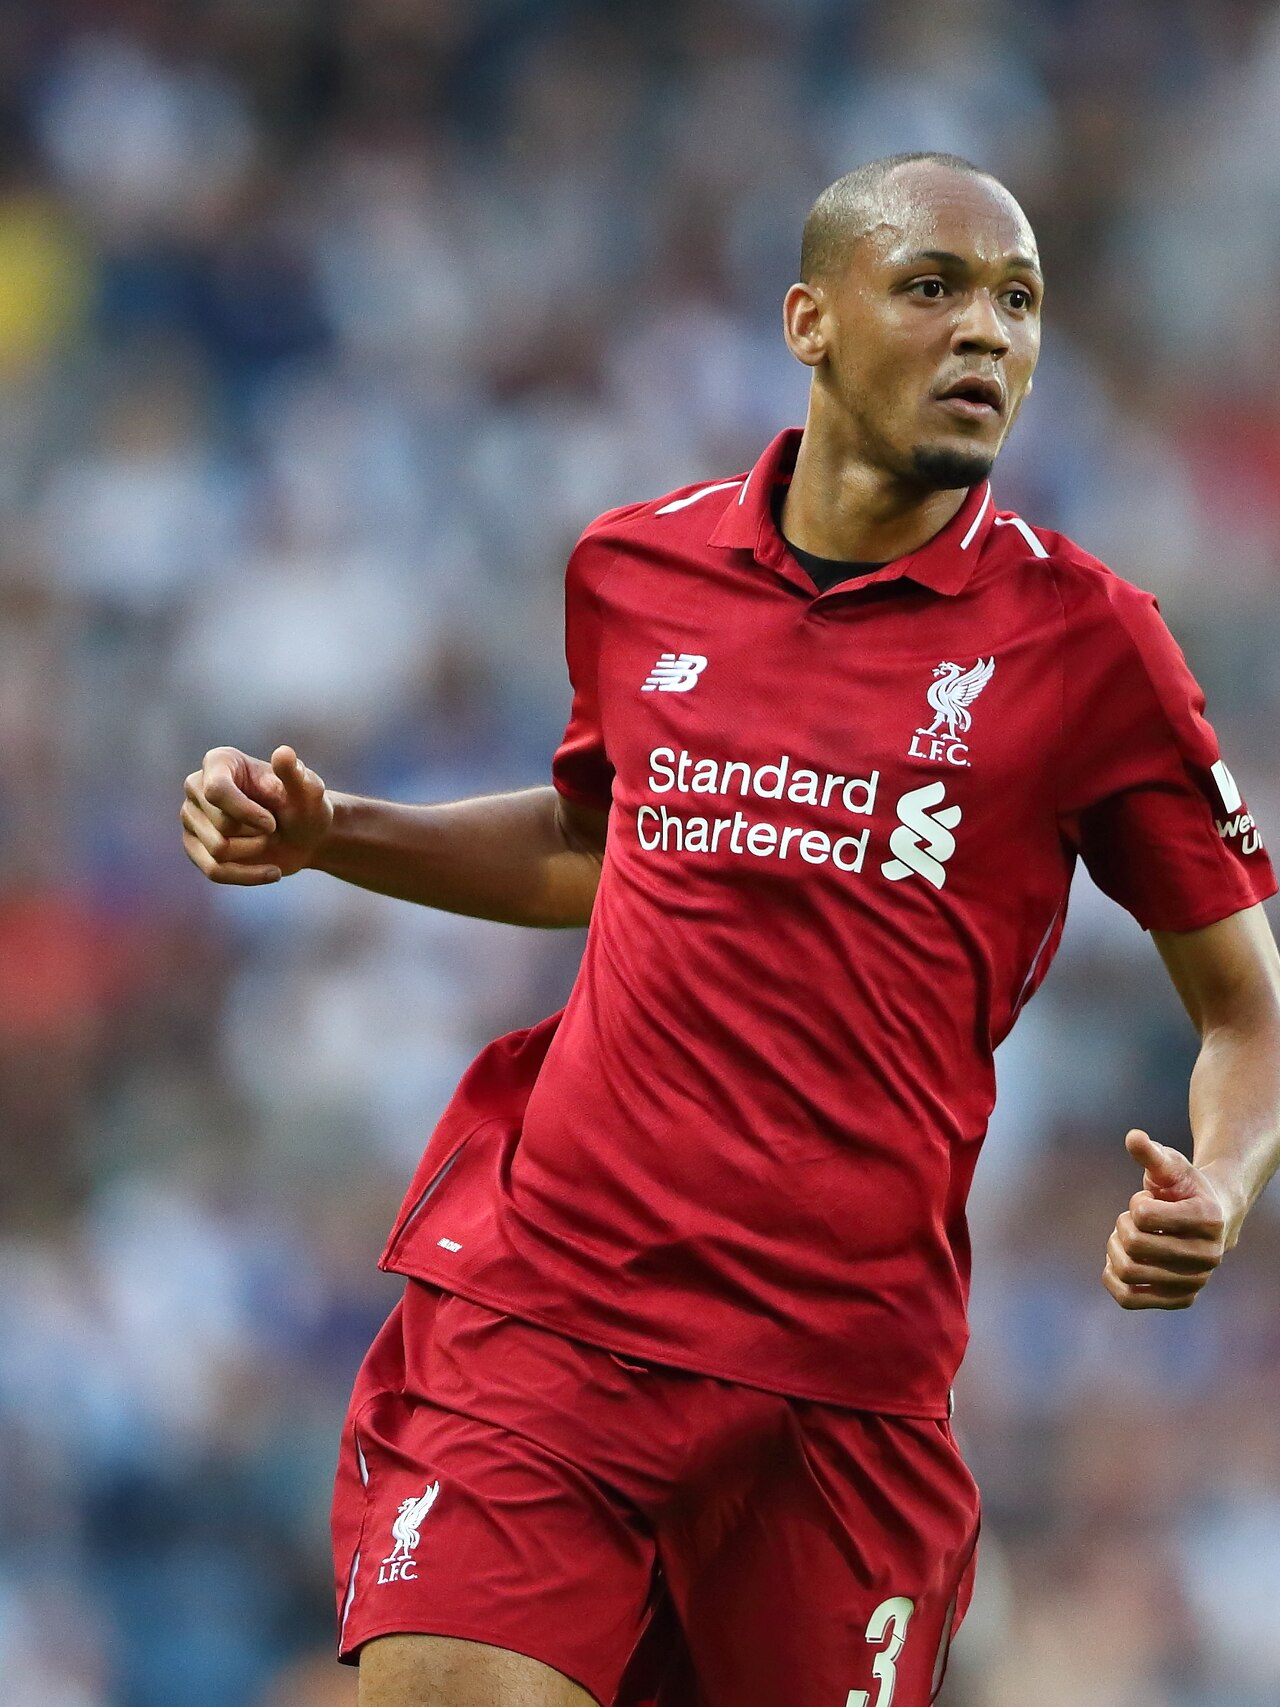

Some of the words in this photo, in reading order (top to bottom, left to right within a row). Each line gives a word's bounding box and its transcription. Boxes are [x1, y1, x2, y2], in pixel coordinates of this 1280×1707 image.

[648, 747, 880, 815] Standard
[907, 735, 971, 767] L.F.C.
[637, 805, 870, 873] Chartered
[846, 1597, 914, 1707] 3
